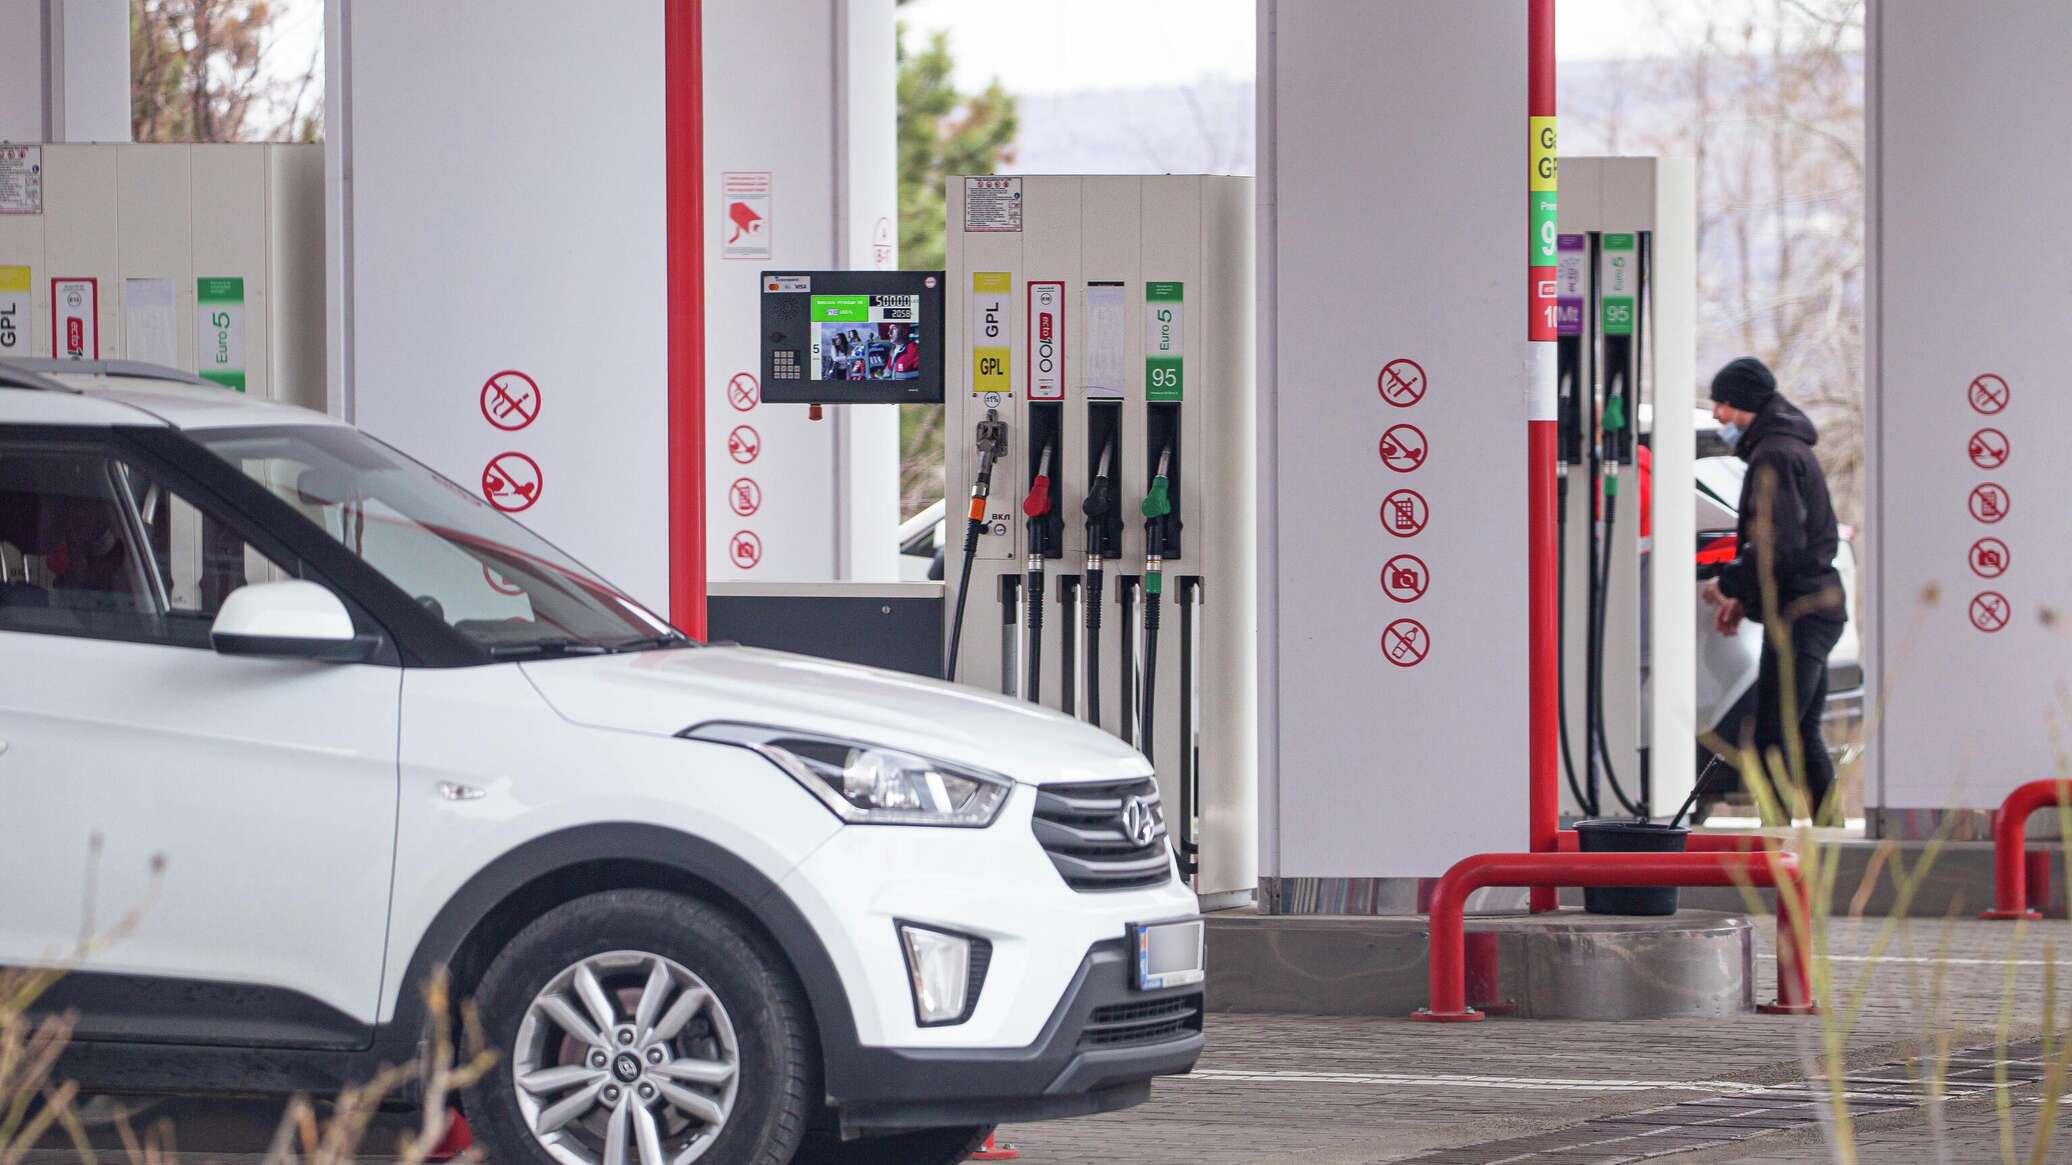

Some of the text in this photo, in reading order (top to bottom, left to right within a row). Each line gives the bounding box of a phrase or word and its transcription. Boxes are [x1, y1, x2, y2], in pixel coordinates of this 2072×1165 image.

[0, 303, 16, 347] GPL
[985, 302, 999, 338] GPL
[1157, 309, 1172, 323] 5
[212, 312, 230, 364] Euro 5
[1160, 325, 1170, 351] Euro
[812, 344, 820, 354] 5
[980, 358, 1004, 376] GPL
[1152, 368, 1177, 387] 95
[991, 513, 1011, 521] ВКЛ
